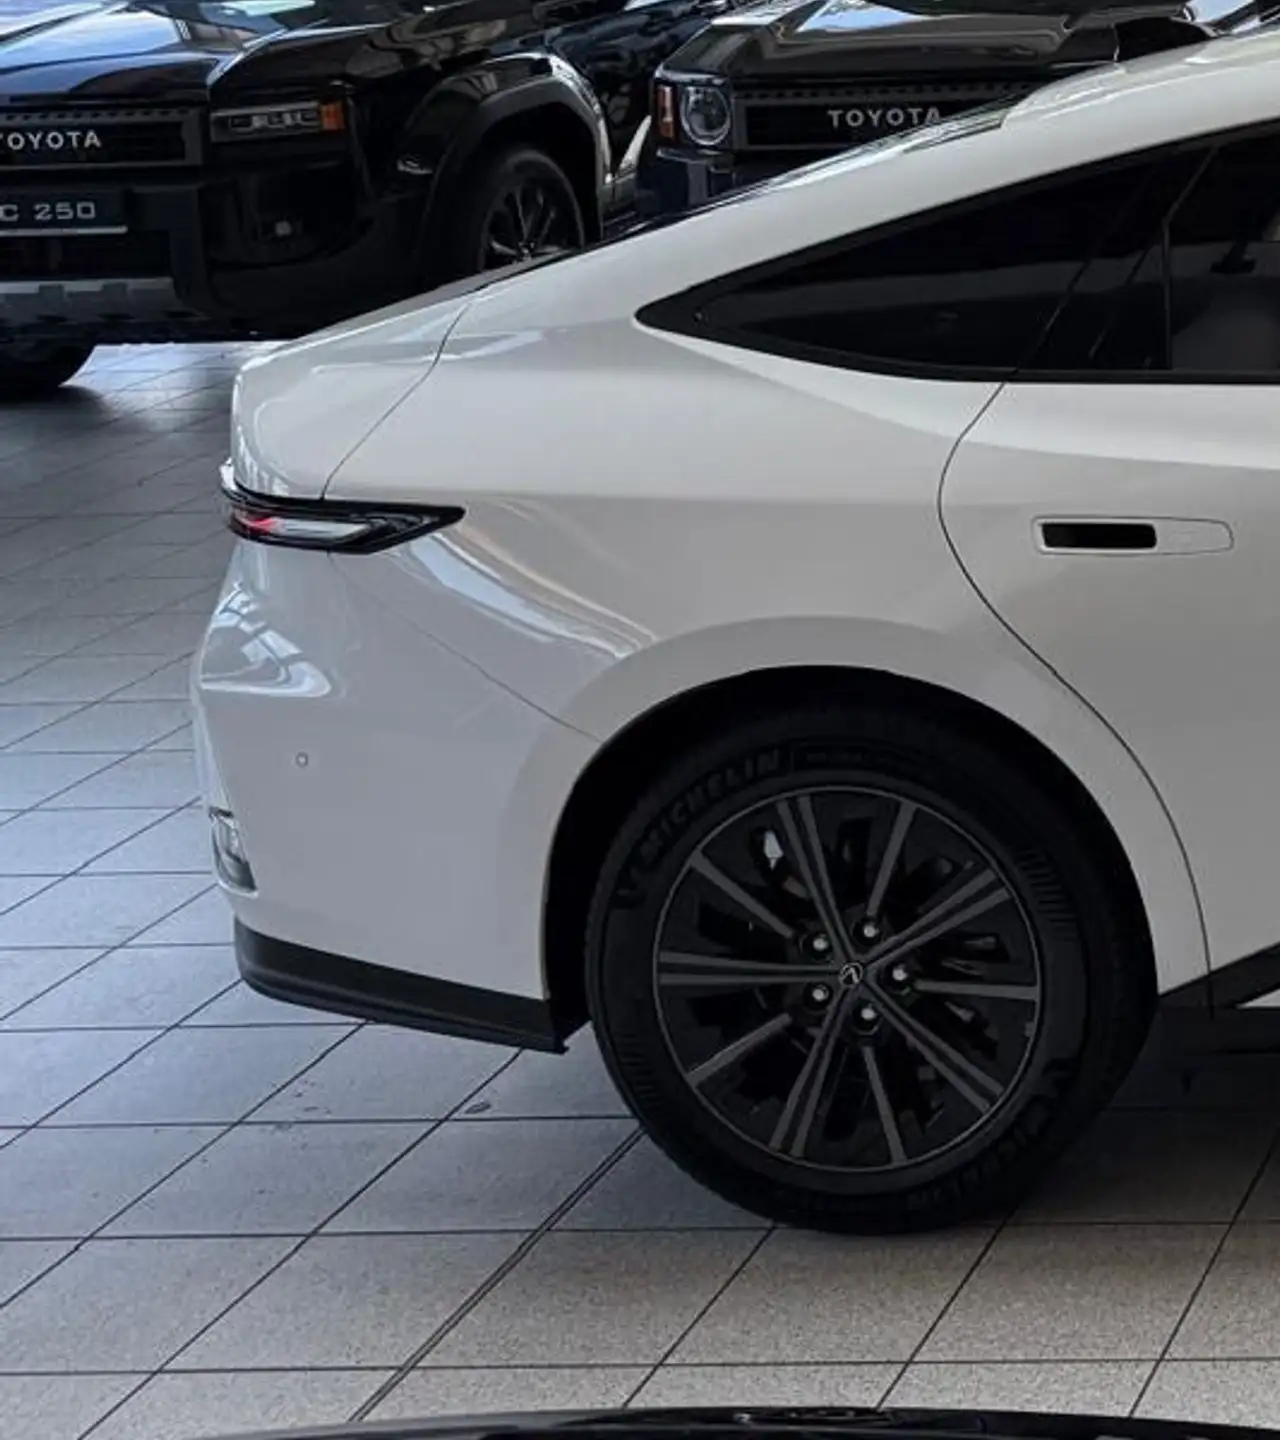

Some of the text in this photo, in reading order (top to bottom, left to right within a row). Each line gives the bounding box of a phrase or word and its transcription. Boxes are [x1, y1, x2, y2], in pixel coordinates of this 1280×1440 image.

[826, 106, 941, 129] TOYOTA
[0, 128, 102, 151] OYOTA
[33, 200, 97, 221] 250
